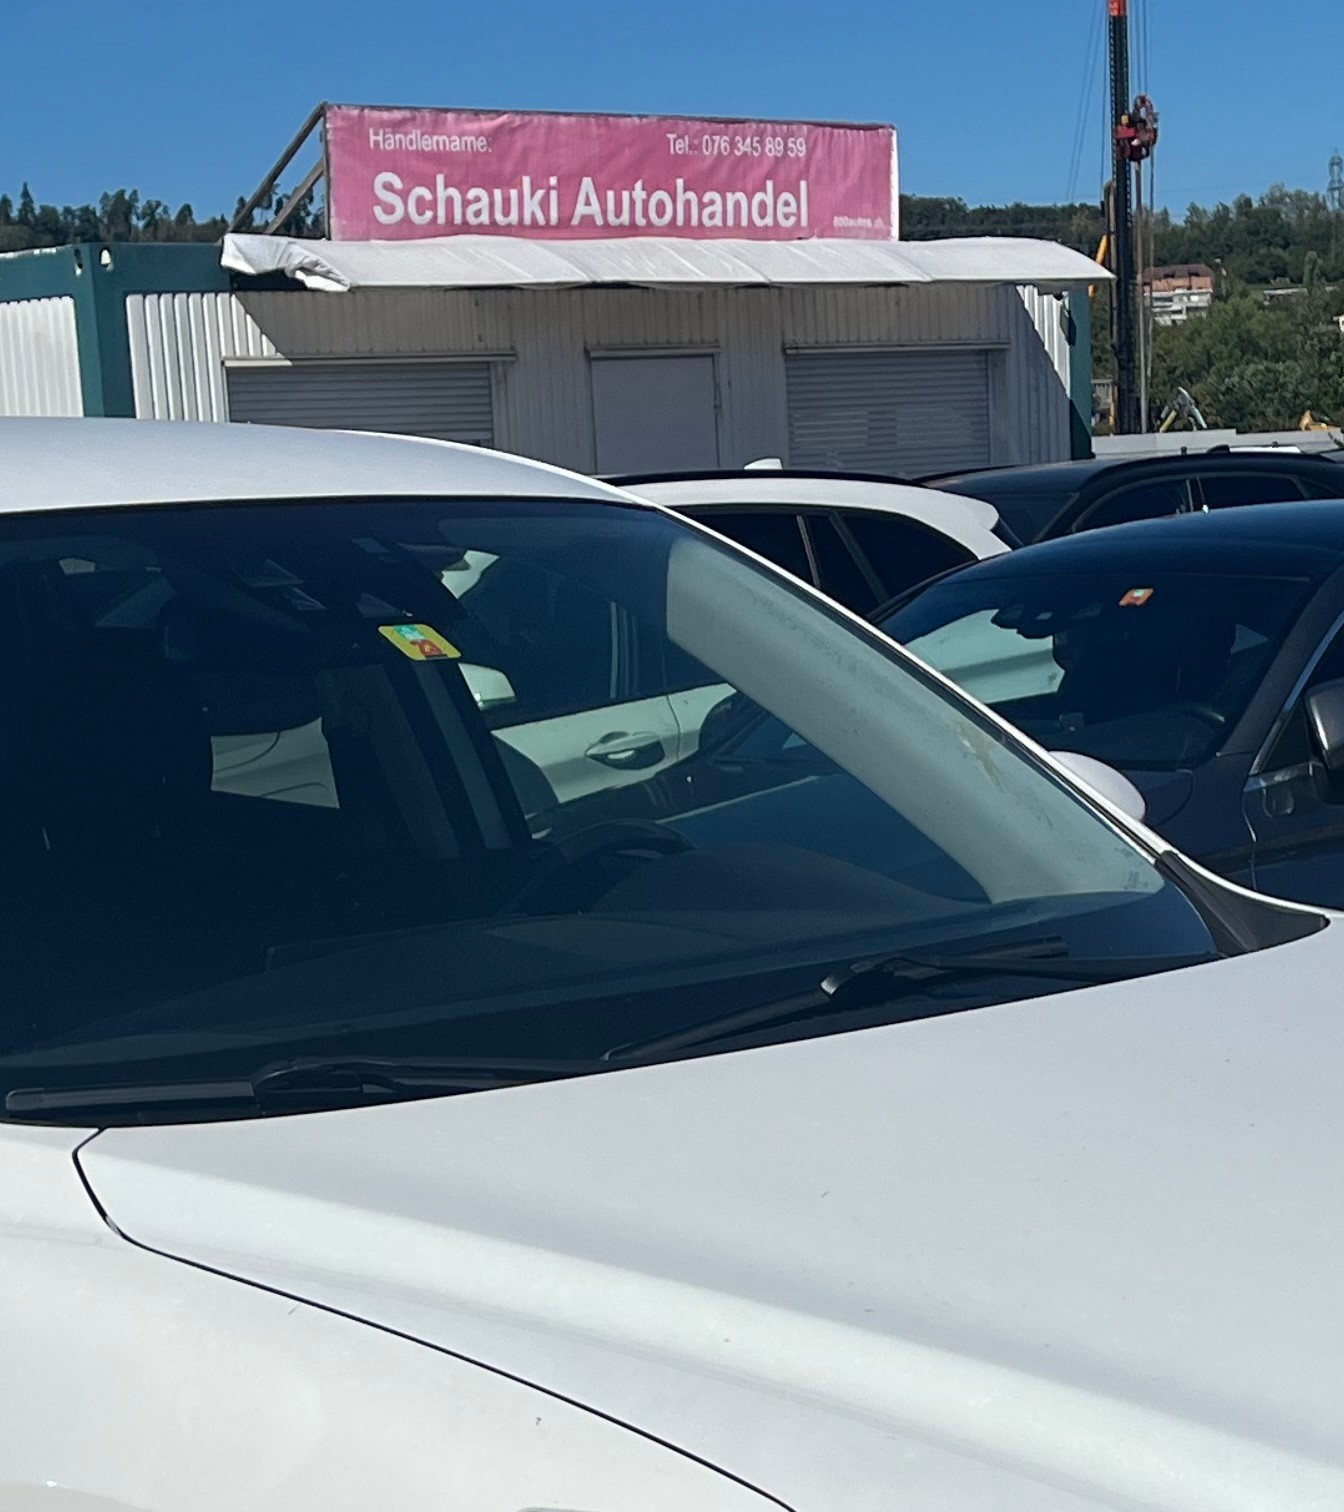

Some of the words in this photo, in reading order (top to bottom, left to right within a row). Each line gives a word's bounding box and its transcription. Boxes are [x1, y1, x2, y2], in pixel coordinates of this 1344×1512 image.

[369, 127, 493, 153] Händlername:
[703, 135, 730, 156] 076
[734, 135, 761, 157] 345
[765, 136, 784, 158] 89
[787, 137, 806, 158] 59
[372, 171, 559, 226] Schauki
[572, 174, 808, 228] Autohandel
